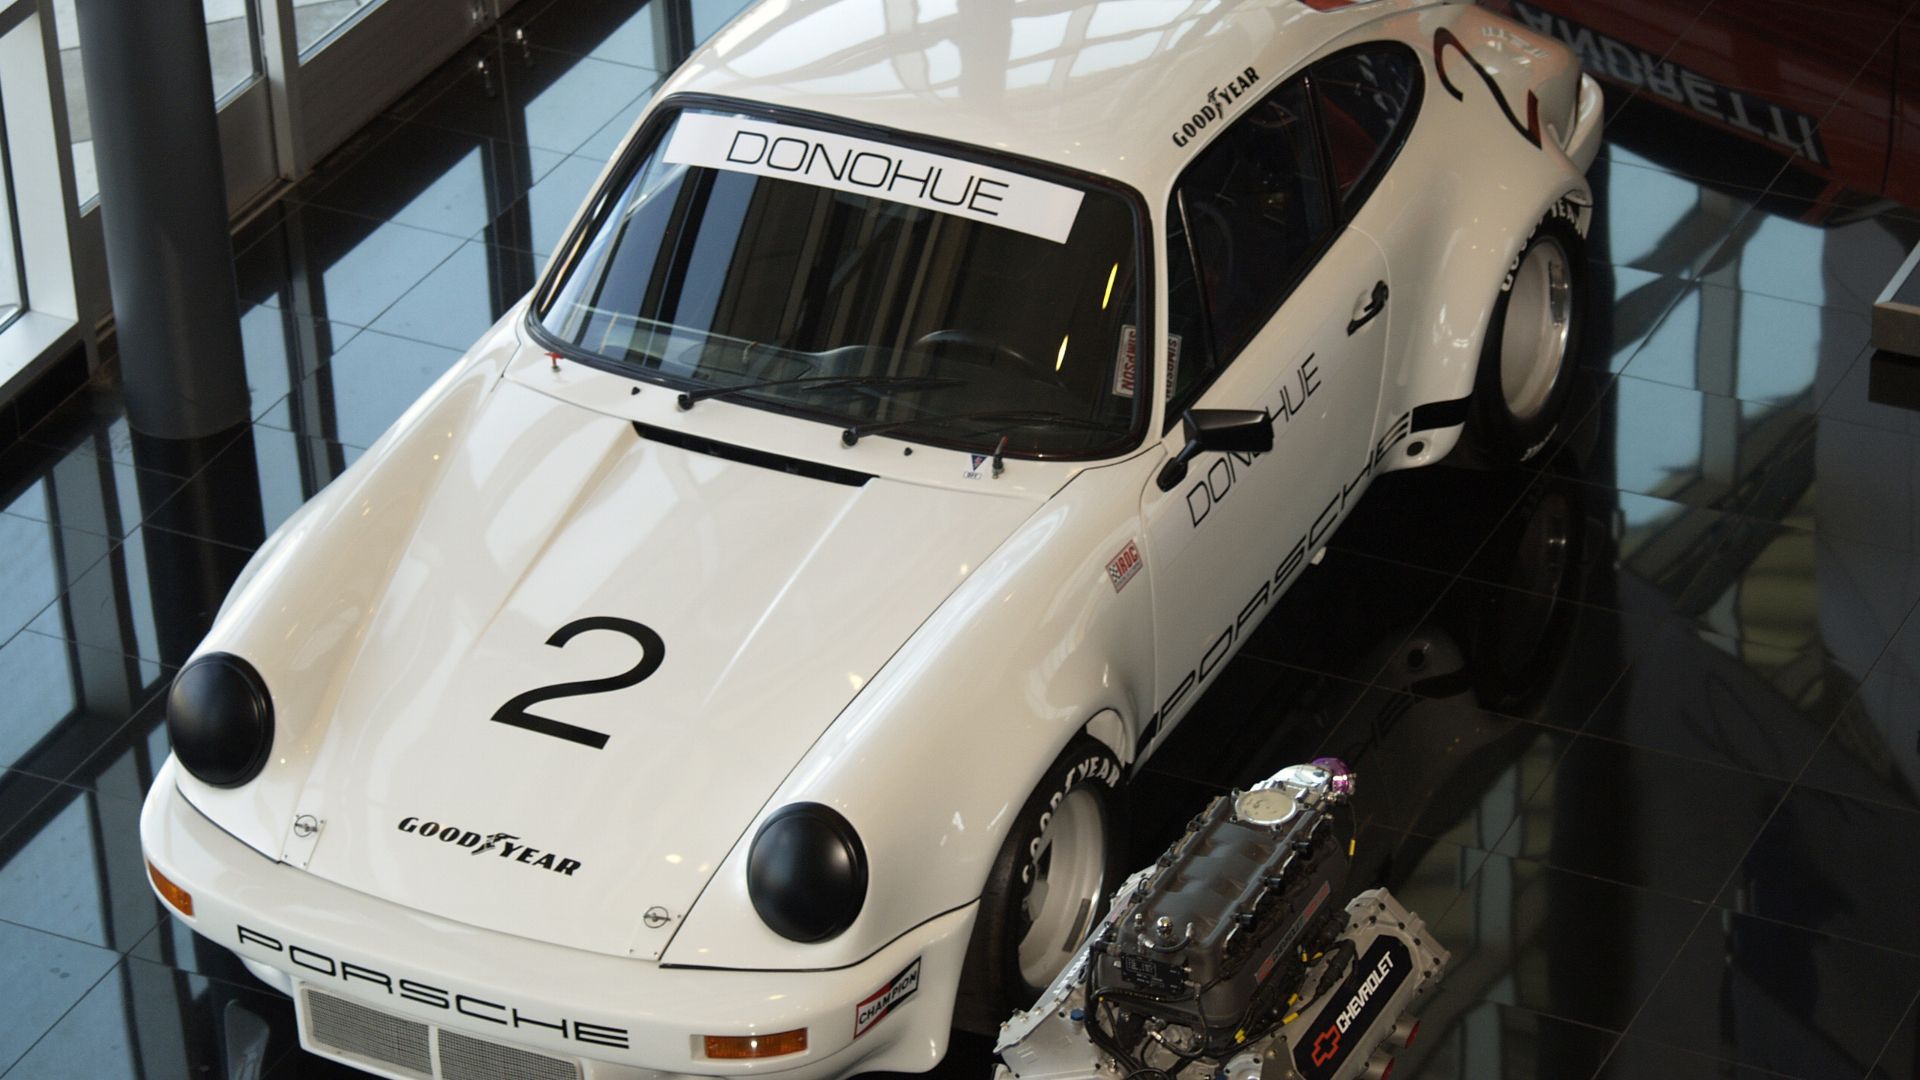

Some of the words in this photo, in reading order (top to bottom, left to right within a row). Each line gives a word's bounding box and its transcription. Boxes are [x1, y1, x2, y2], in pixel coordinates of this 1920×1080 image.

[1433, 27, 1542, 150] 2
[726, 130, 1010, 216] DONOHUE
[1187, 353, 1322, 528] DONHUE
[1115, 546, 1138, 576] IROC
[1157, 411, 1410, 732] PORSCHE
[490, 616, 666, 750] 2
[237, 925, 630, 1049] PORSCHE
[859, 971, 917, 1024] CHAMPION
[1336, 951, 1394, 1034] CHEVROLET
